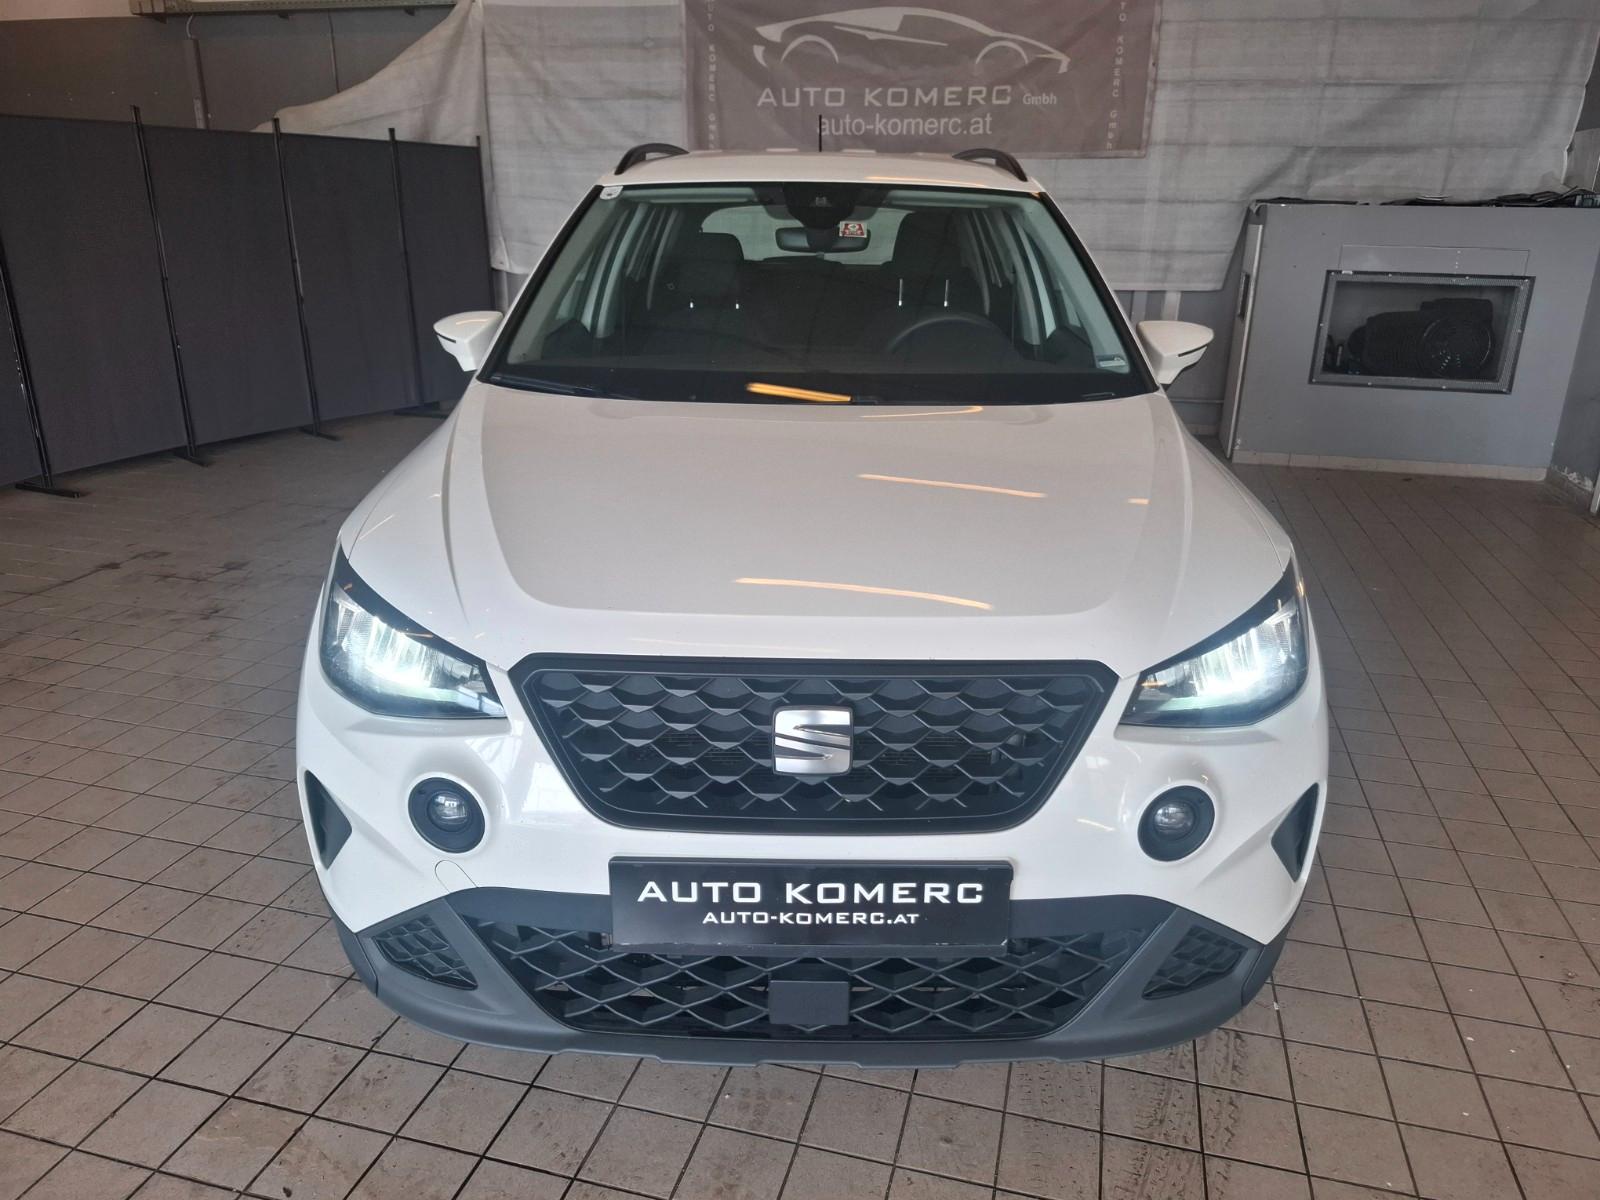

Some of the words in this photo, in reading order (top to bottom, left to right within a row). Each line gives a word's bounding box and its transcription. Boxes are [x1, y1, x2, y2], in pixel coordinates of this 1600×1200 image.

[1112, 35, 1124, 97] KOMERC
[756, 87, 846, 107] AUTO
[863, 85, 1012, 107] KOMERC
[1022, 92, 1057, 105] Gmbh
[817, 112, 993, 136] auto-komerc.at
[637, 881, 761, 903] AUTO
[785, 882, 984, 904] KOMERC
[702, 911, 920, 925] AUTO-KOMERC.AT
